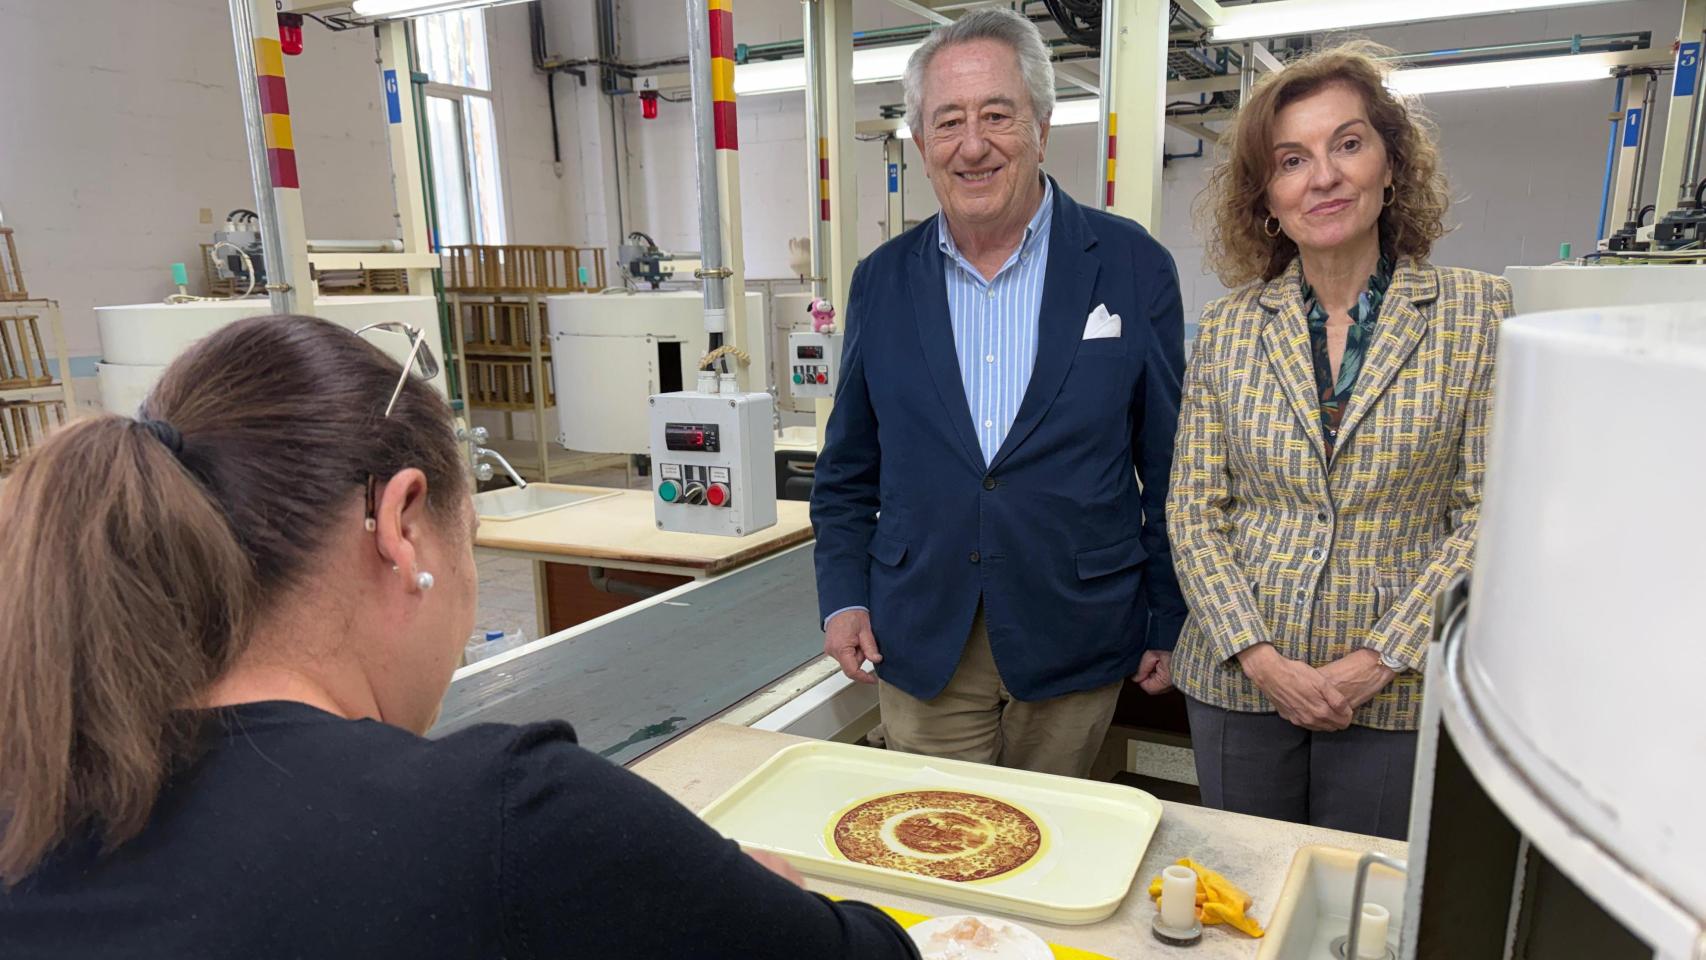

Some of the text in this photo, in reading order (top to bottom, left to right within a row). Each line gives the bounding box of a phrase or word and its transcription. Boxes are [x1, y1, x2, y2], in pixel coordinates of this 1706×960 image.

[387, 77, 397, 95] 6
[643, 77, 650, 89] 4
[1628, 113, 1636, 126] 1
